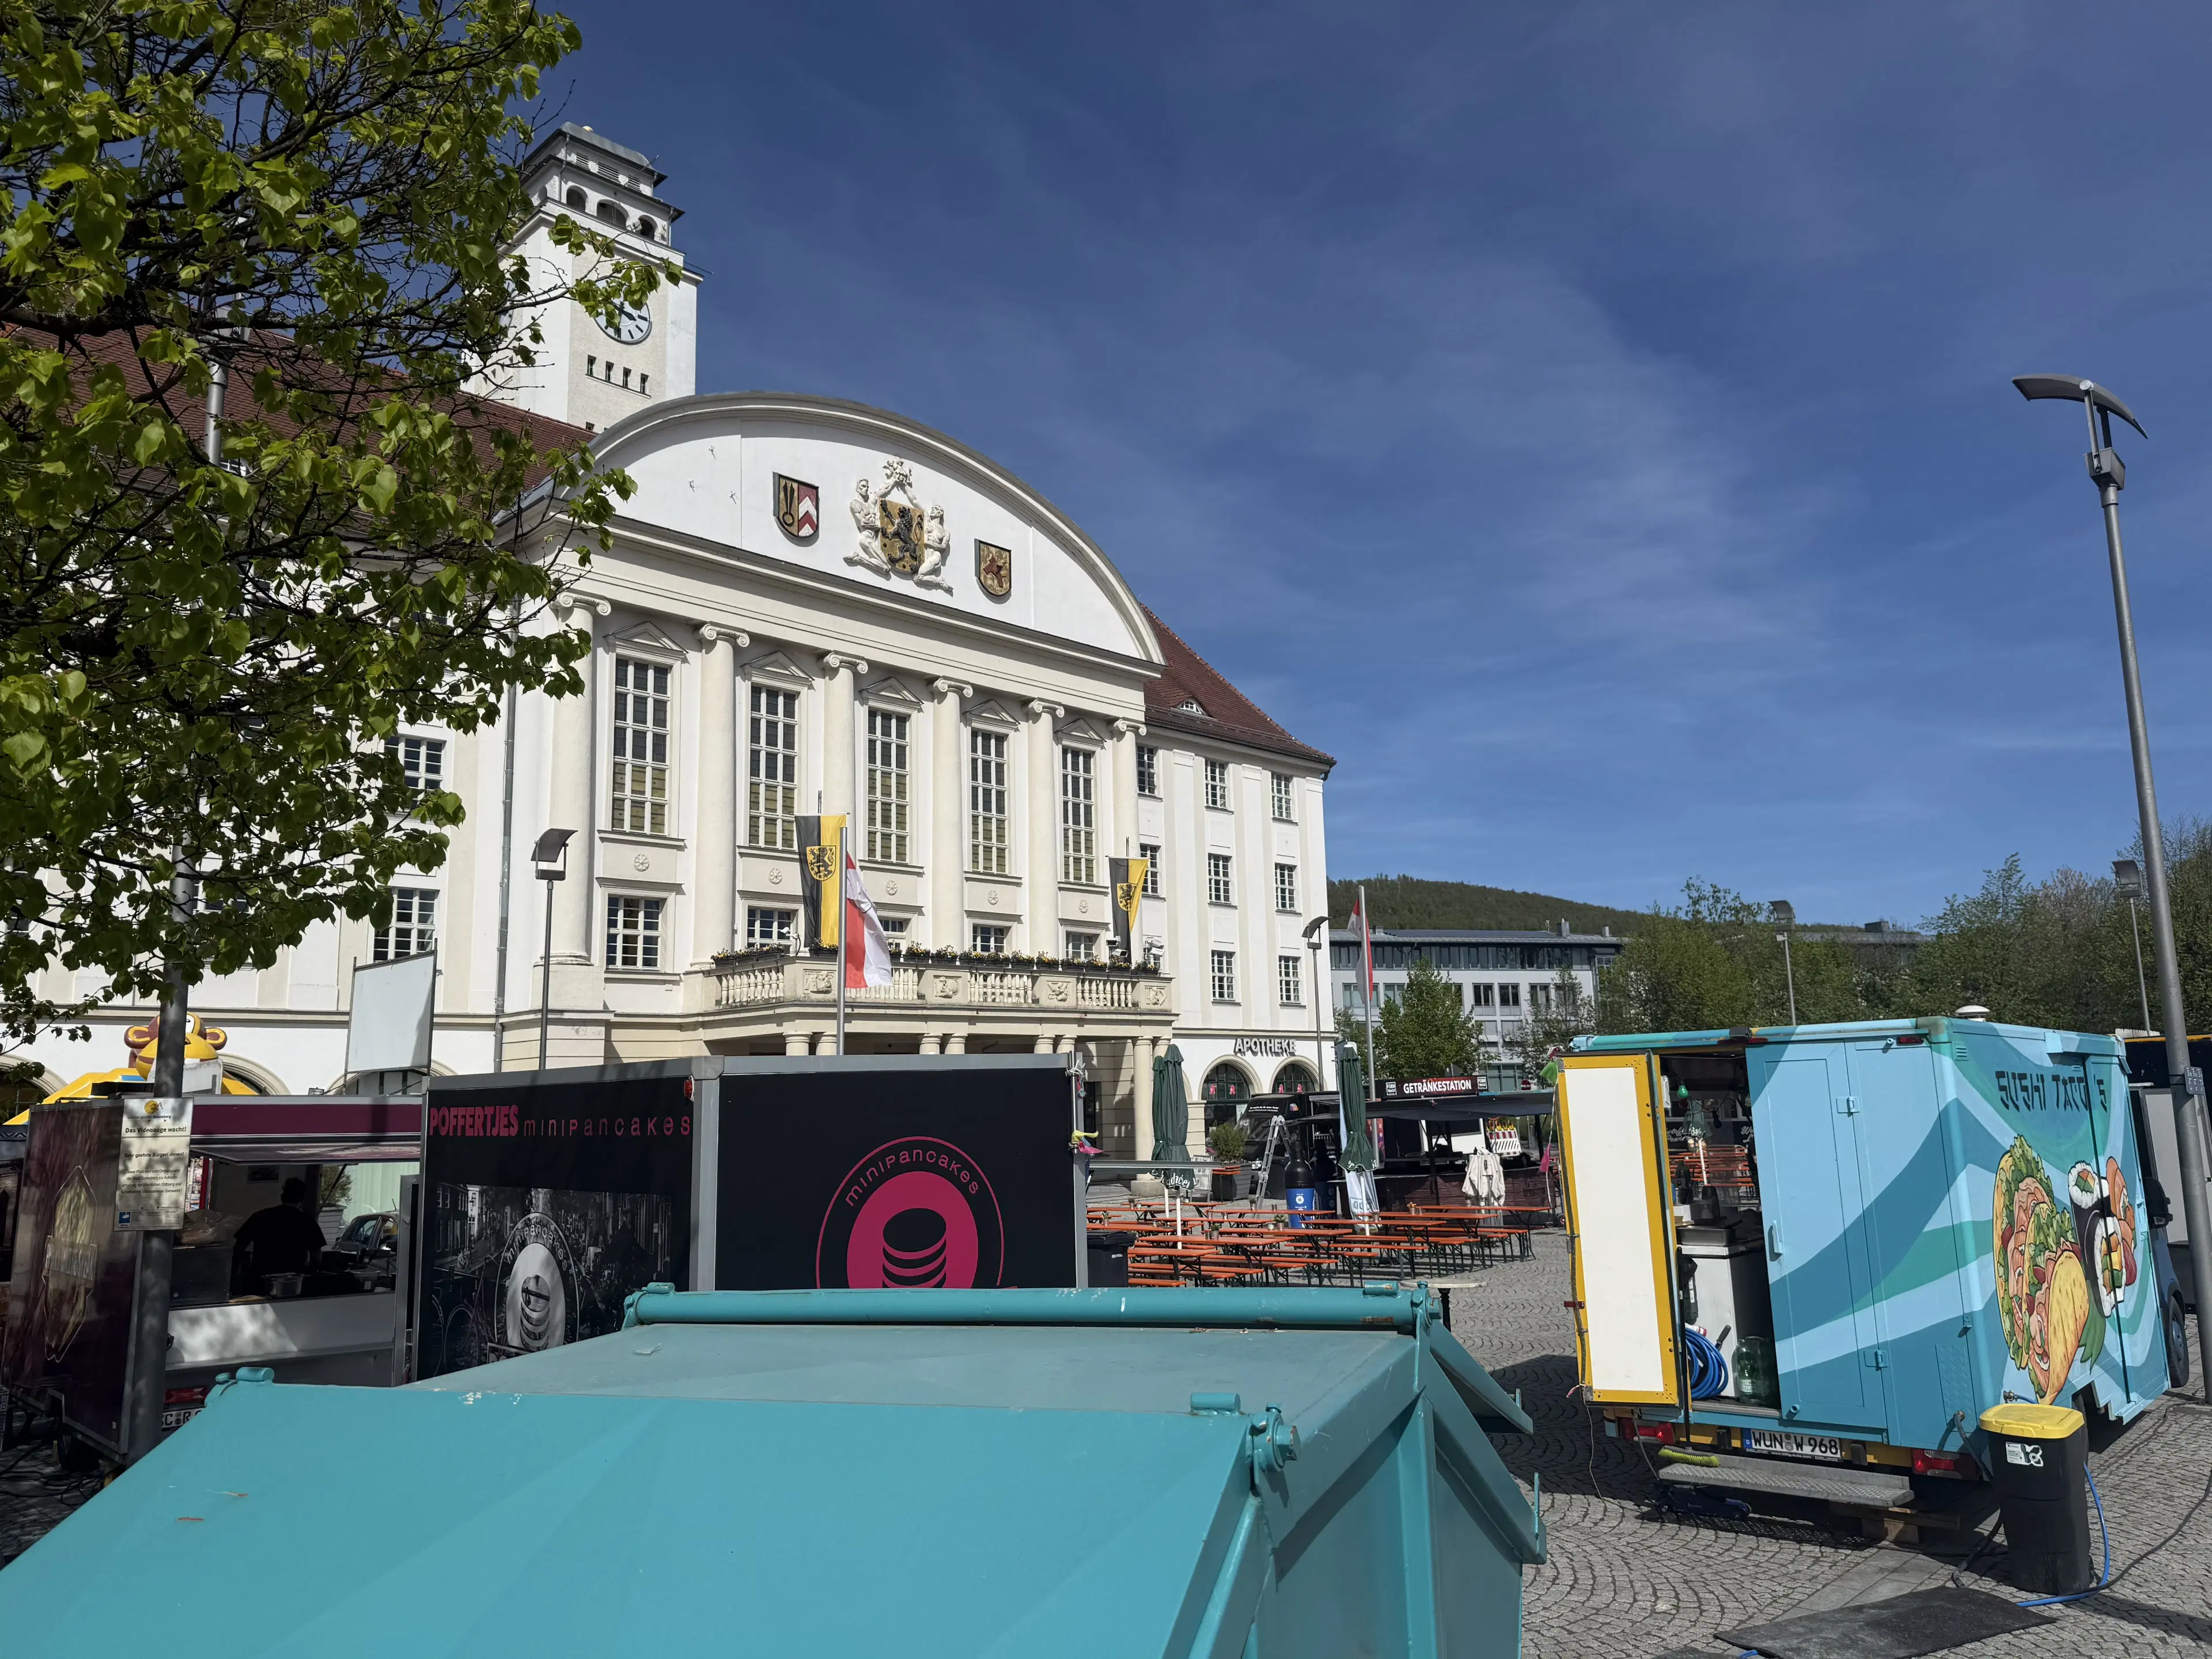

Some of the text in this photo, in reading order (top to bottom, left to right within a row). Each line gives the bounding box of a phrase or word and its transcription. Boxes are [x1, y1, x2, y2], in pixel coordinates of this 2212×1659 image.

[1234, 1037, 1297, 1052] APOTHEKE
[1403, 1080, 1472, 1093] GETRÄNKESTATION
[1995, 1070, 2046, 1112] SUSHI
[429, 1105, 518, 1137] POFFERTJES
[1752, 1431, 1784, 1449] WUN
[1794, 1435, 1804, 1452] W
[1808, 1437, 1838, 1455] 968
